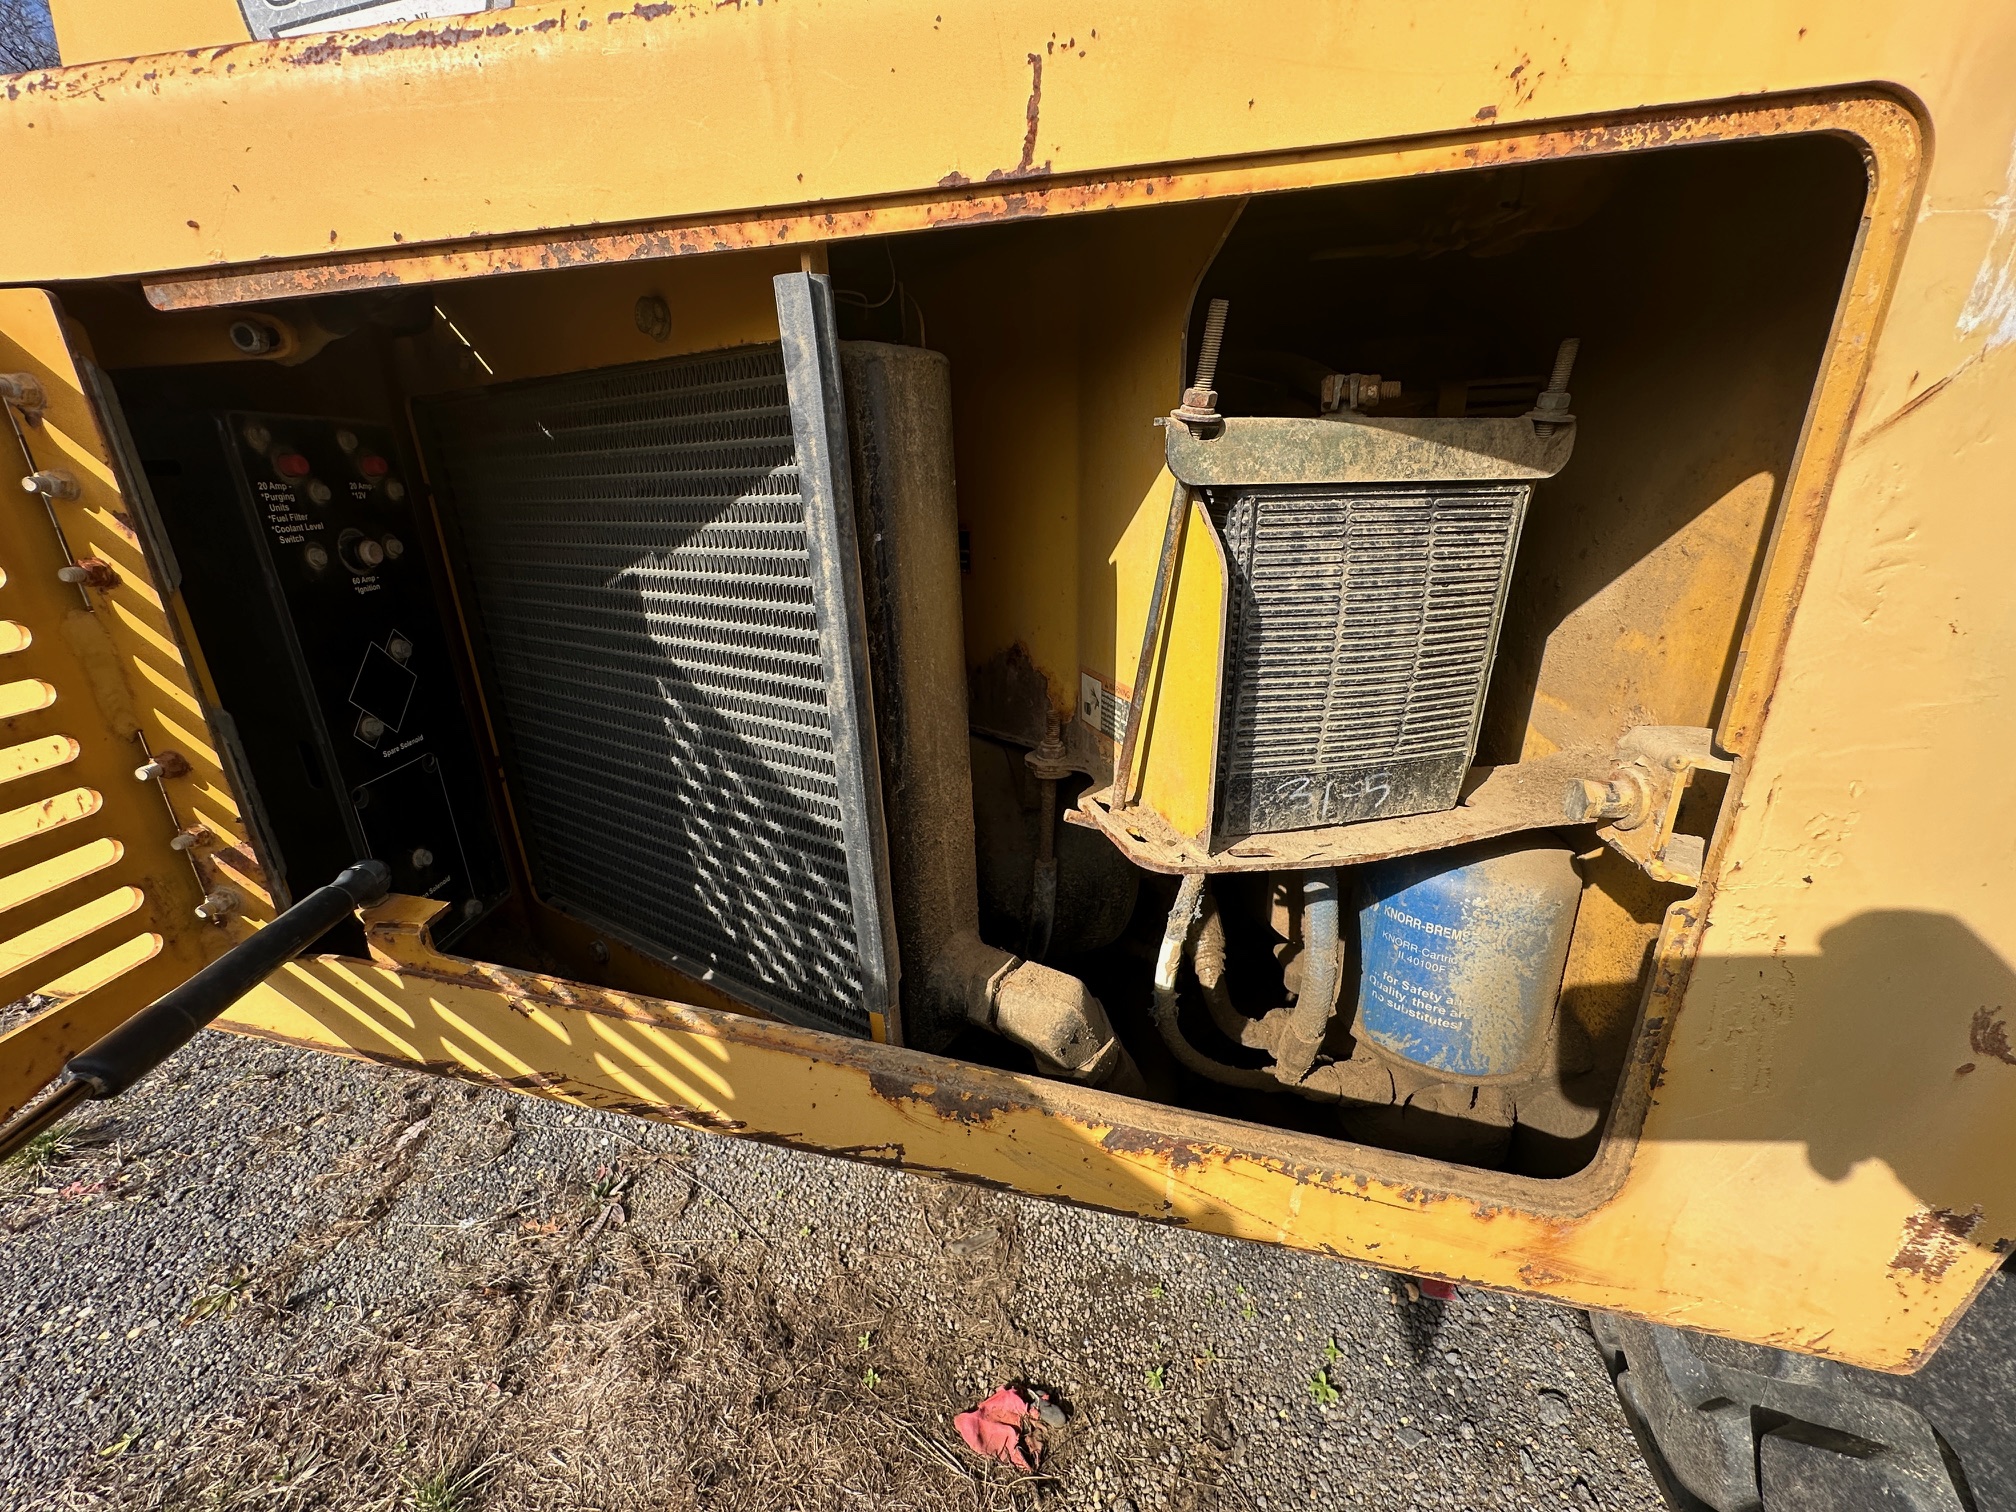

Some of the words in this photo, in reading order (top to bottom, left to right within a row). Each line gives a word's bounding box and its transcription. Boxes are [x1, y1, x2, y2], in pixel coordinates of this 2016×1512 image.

[257, 481, 268, 491] 20
[269, 481, 288, 492] Amp
[349, 481, 359, 490] 20
[359, 482, 373, 491] Amp
[269, 503, 290, 513] Units
[289, 513, 309, 522] Filter
[304, 522, 325, 532] Level
[279, 534, 305, 545] Switch
[361, 575, 376, 584] Amp
[382, 746, 400, 758] Spare
[400, 733, 424, 750] Solenoid
[1383, 904, 1472, 943] KNORR-BREMS
[1382, 971, 1399, 986] for
[1401, 980, 1442, 1003] Safety
[1371, 989, 1385, 1002] no
[1387, 999, 1463, 1032] substitutes!
[1412, 997, 1447, 1015] there
